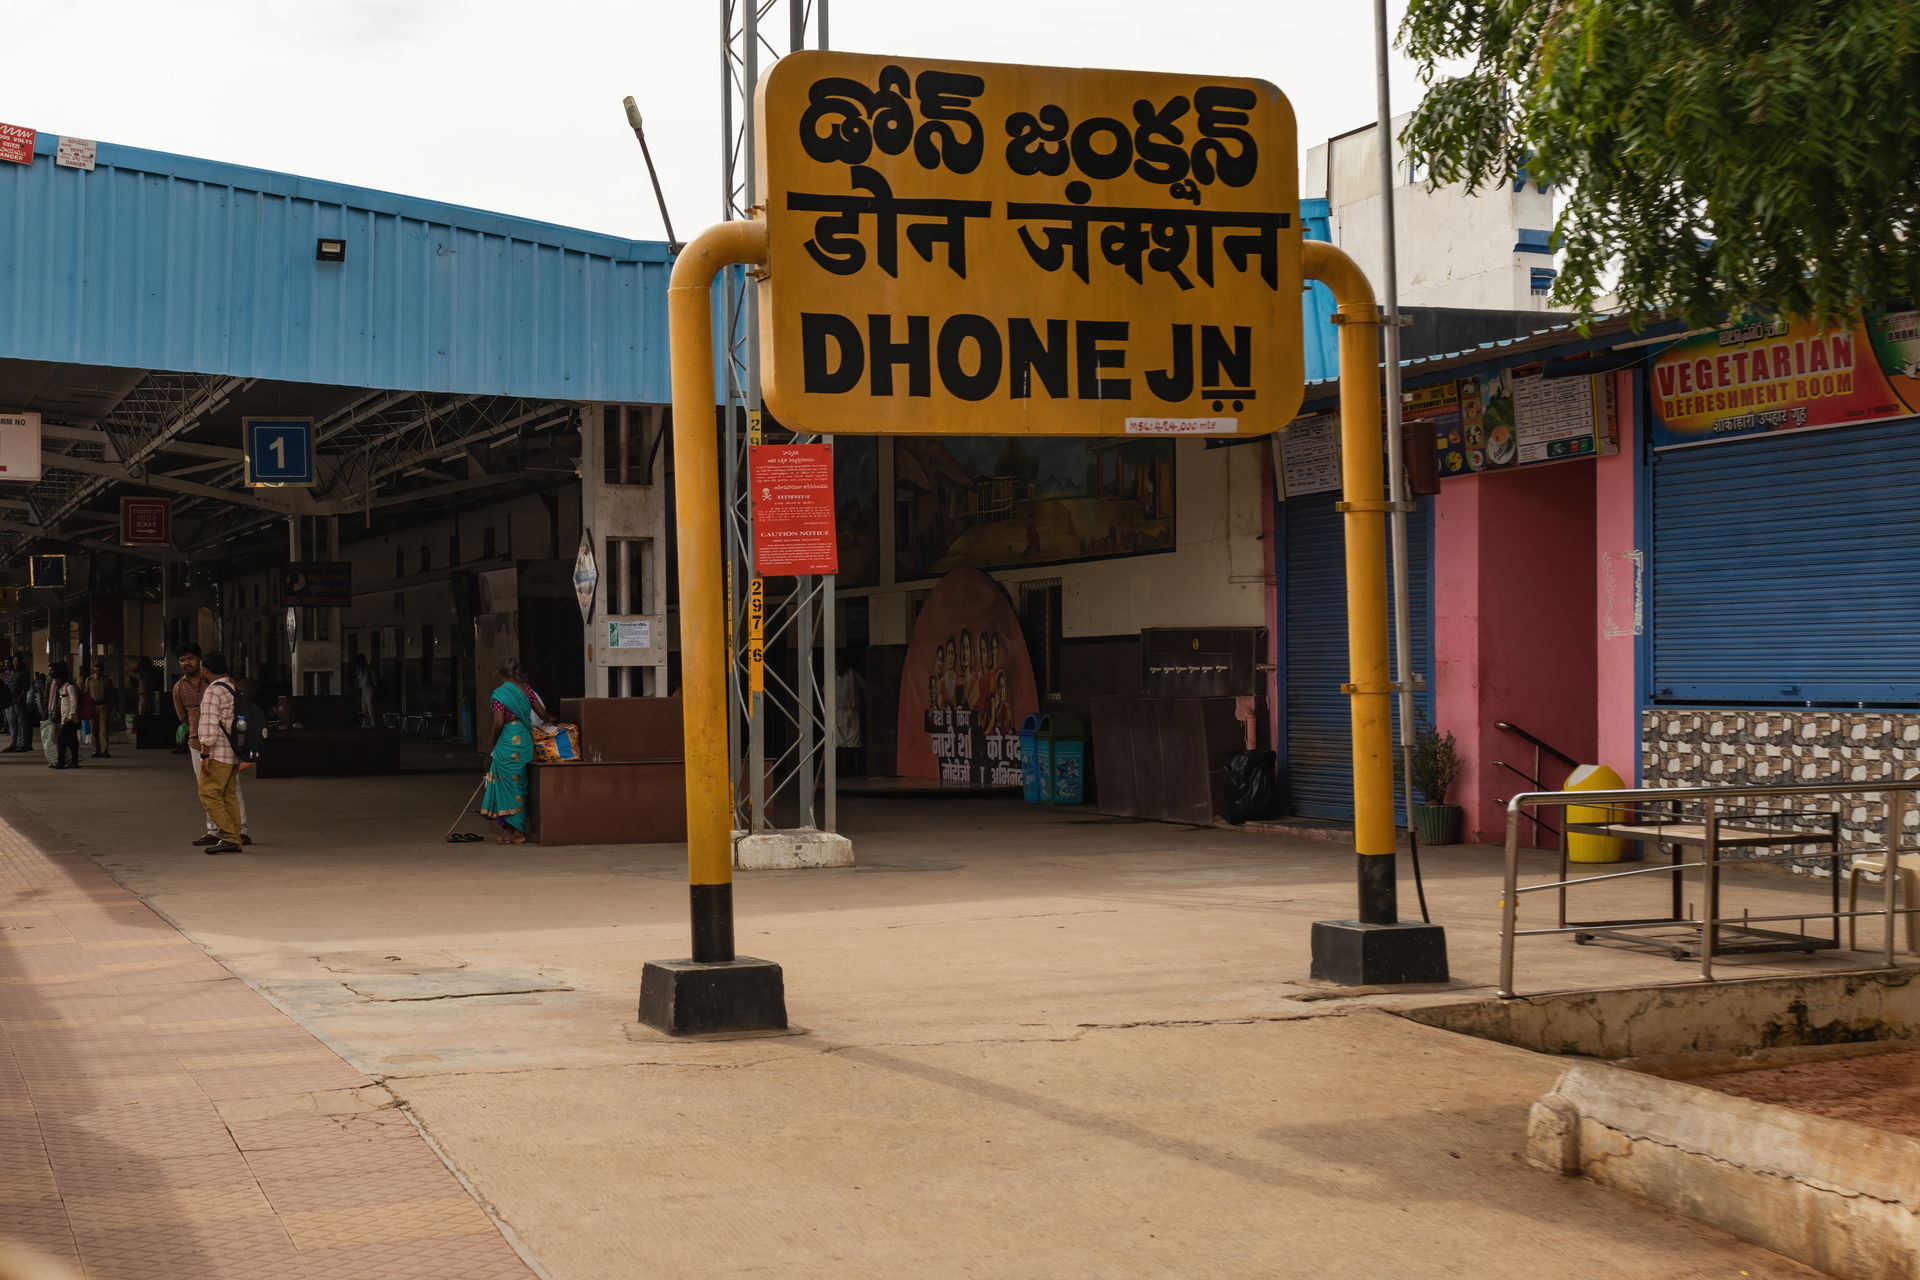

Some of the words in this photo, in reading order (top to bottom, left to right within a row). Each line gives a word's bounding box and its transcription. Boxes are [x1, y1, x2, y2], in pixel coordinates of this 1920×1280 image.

[0, 152, 24, 161] ANGER
[787, 165, 993, 280] डोन
[1006, 180, 1292, 292] जंक्शन
[800, 311, 1132, 402] DHONE
[1144, 323, 1257, 405] JN
[1655, 333, 1854, 401] VEGETARIAN
[1663, 381, 1789, 420] REFRESHMENT
[1795, 371, 1853, 400] ROOM
[14, 418, 27, 426] NO
[269, 436, 285, 469] 1
